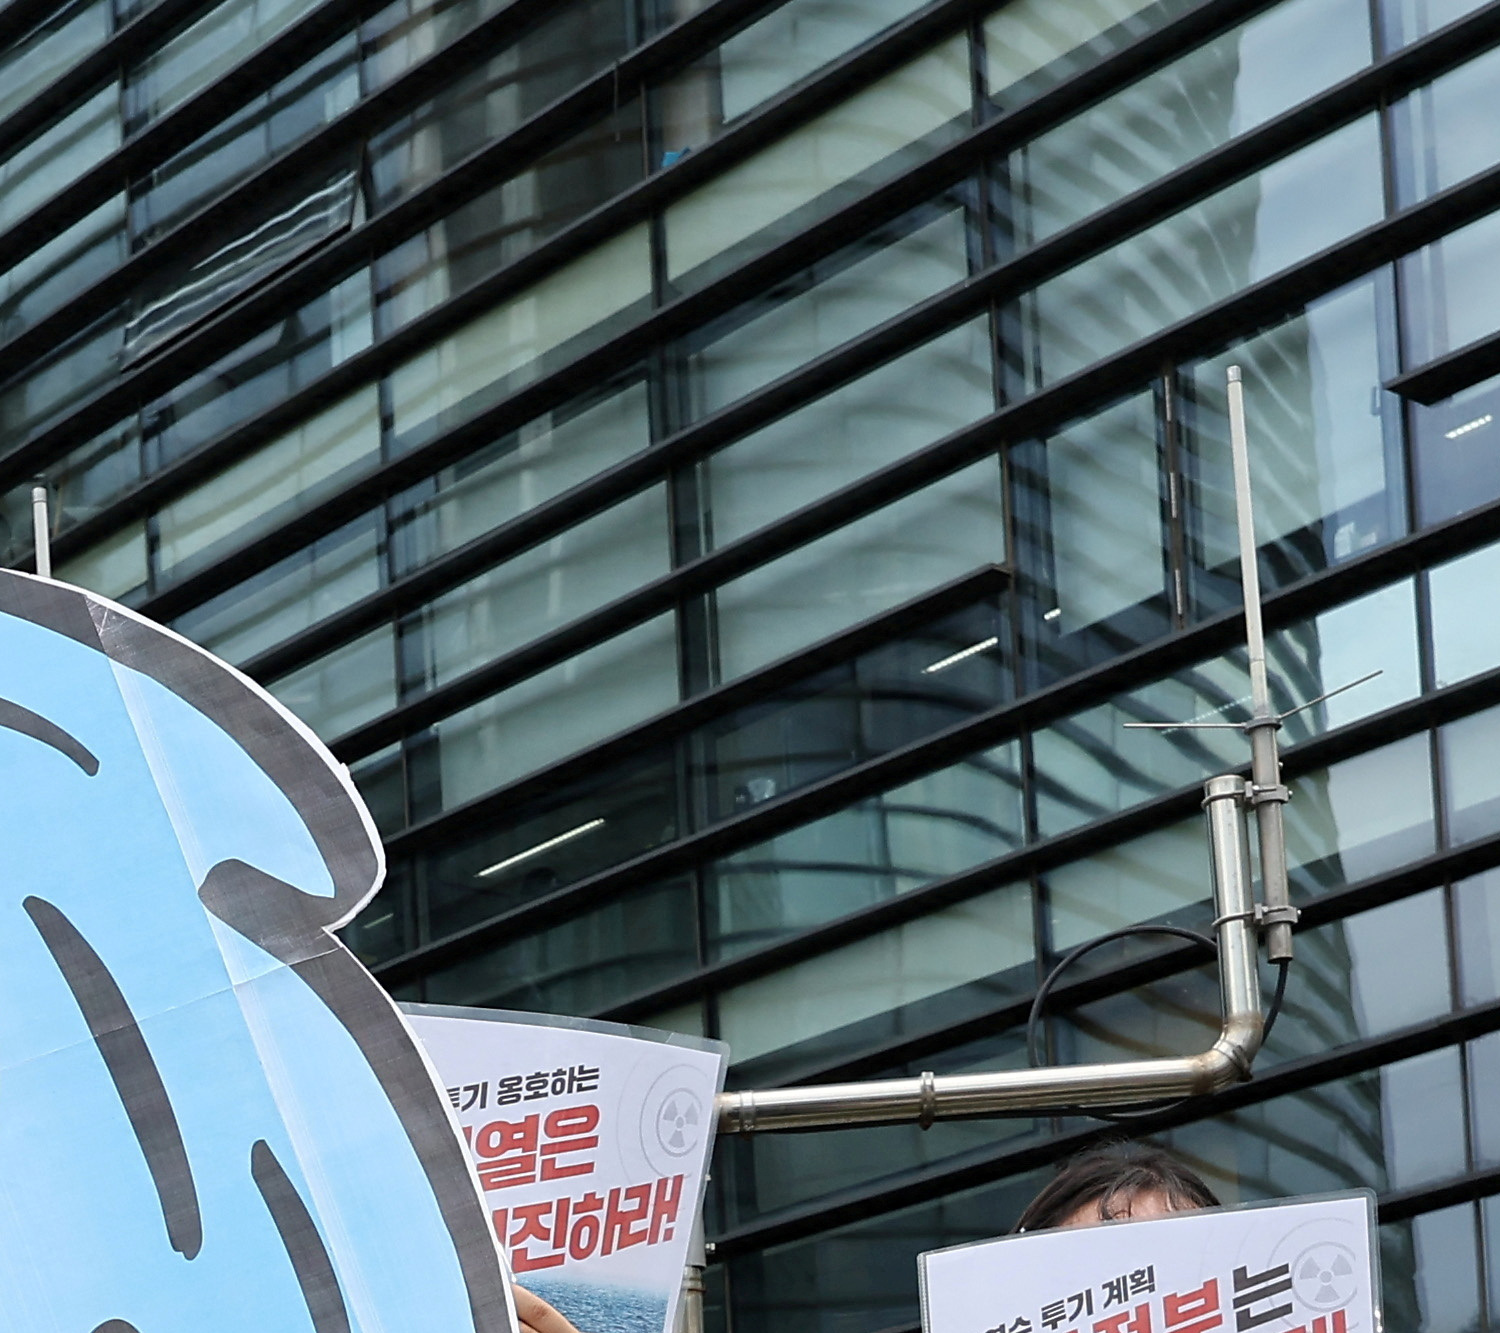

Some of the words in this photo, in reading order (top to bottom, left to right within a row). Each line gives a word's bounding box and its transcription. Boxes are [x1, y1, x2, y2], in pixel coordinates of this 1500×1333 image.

[497, 1065, 600, 1106] 옹호하는
[462, 1104, 601, 1191] 열은
[491, 1174, 684, 1274] 진하라!
[1041, 1288, 1094, 1331] 투기
[1101, 1264, 1156, 1310] 계획
